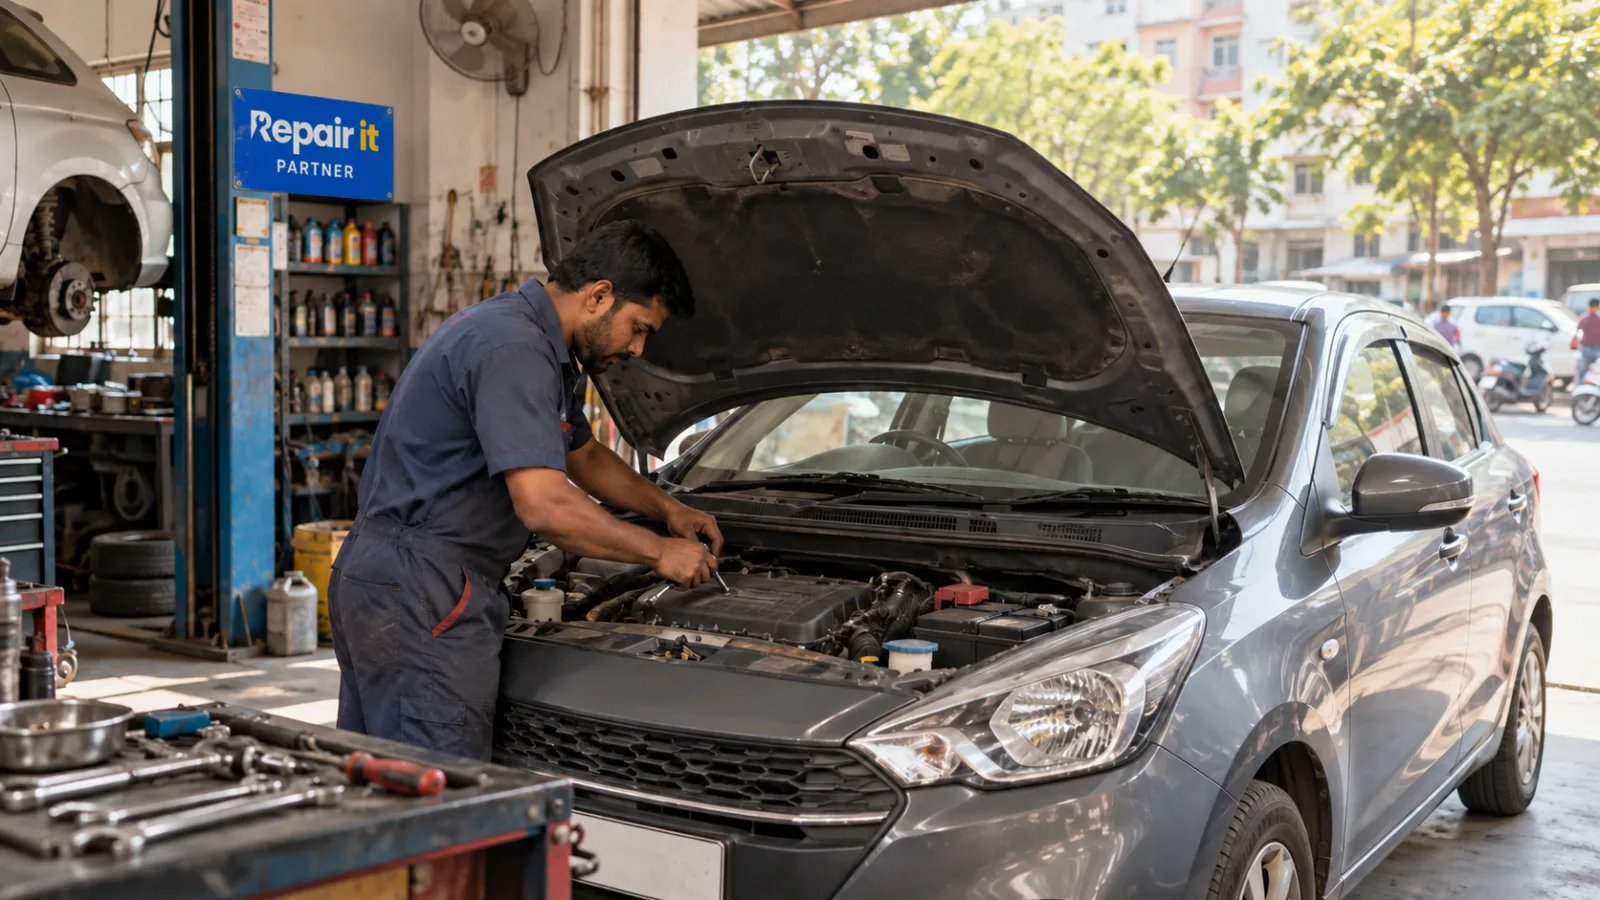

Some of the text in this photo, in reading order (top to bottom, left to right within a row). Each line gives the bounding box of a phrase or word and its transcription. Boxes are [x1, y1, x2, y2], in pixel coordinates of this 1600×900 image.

[250, 109, 379, 155] Repair it
[276, 159, 354, 179] PARTNER
